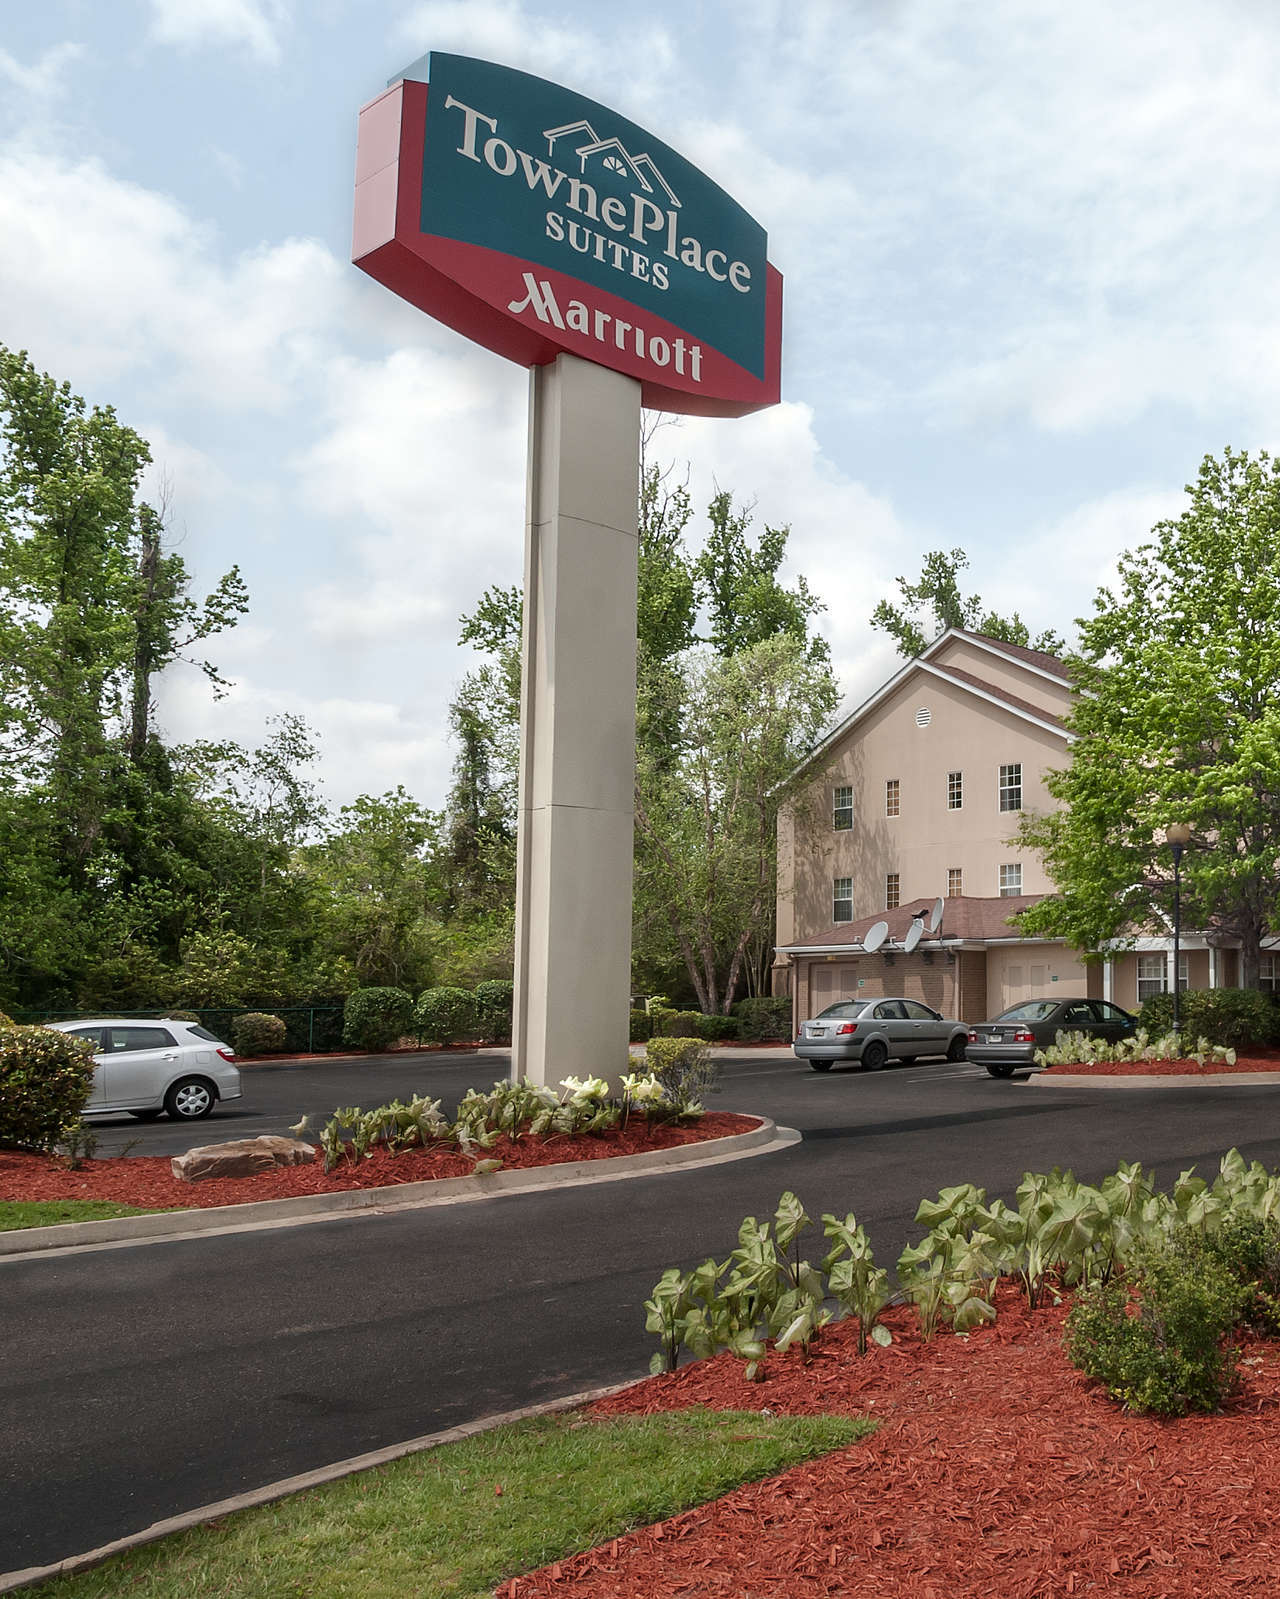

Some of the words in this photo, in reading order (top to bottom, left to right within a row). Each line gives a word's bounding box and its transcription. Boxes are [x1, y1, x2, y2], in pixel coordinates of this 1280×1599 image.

[444, 95, 752, 293] TownePlace
[545, 211, 670, 291] SUITES
[507, 272, 703, 382] Marriott
